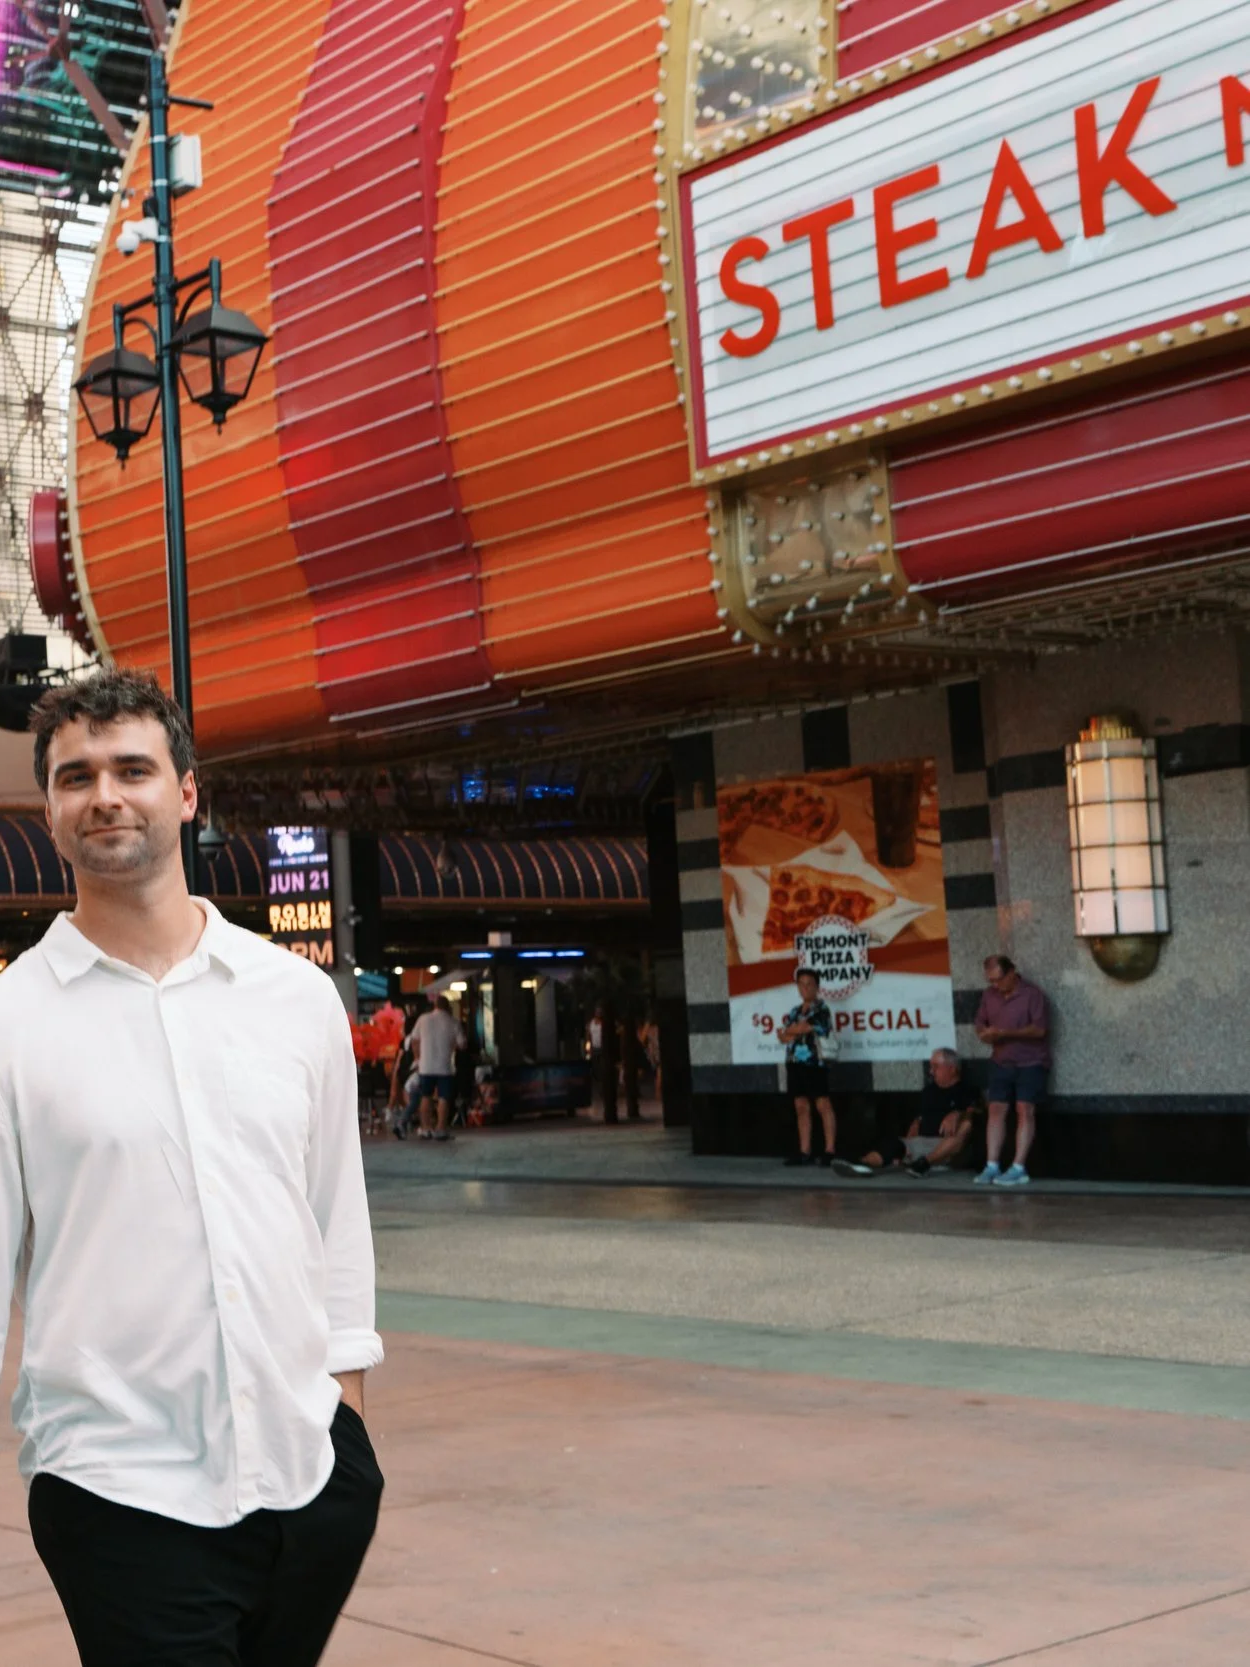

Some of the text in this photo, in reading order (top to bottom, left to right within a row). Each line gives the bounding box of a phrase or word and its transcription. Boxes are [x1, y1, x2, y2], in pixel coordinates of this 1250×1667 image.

[718, 76, 1178, 360] STEAK
[269, 869, 329, 895] JUN 21
[269, 901, 332, 924] ROBIN
[277, 939, 334, 966] PM
[796, 933, 867, 950] FREMONT
[811, 950, 854, 966] PIZZA
[815, 966, 871, 982] MPANY
[834, 1008, 930, 1033] PECIAL
